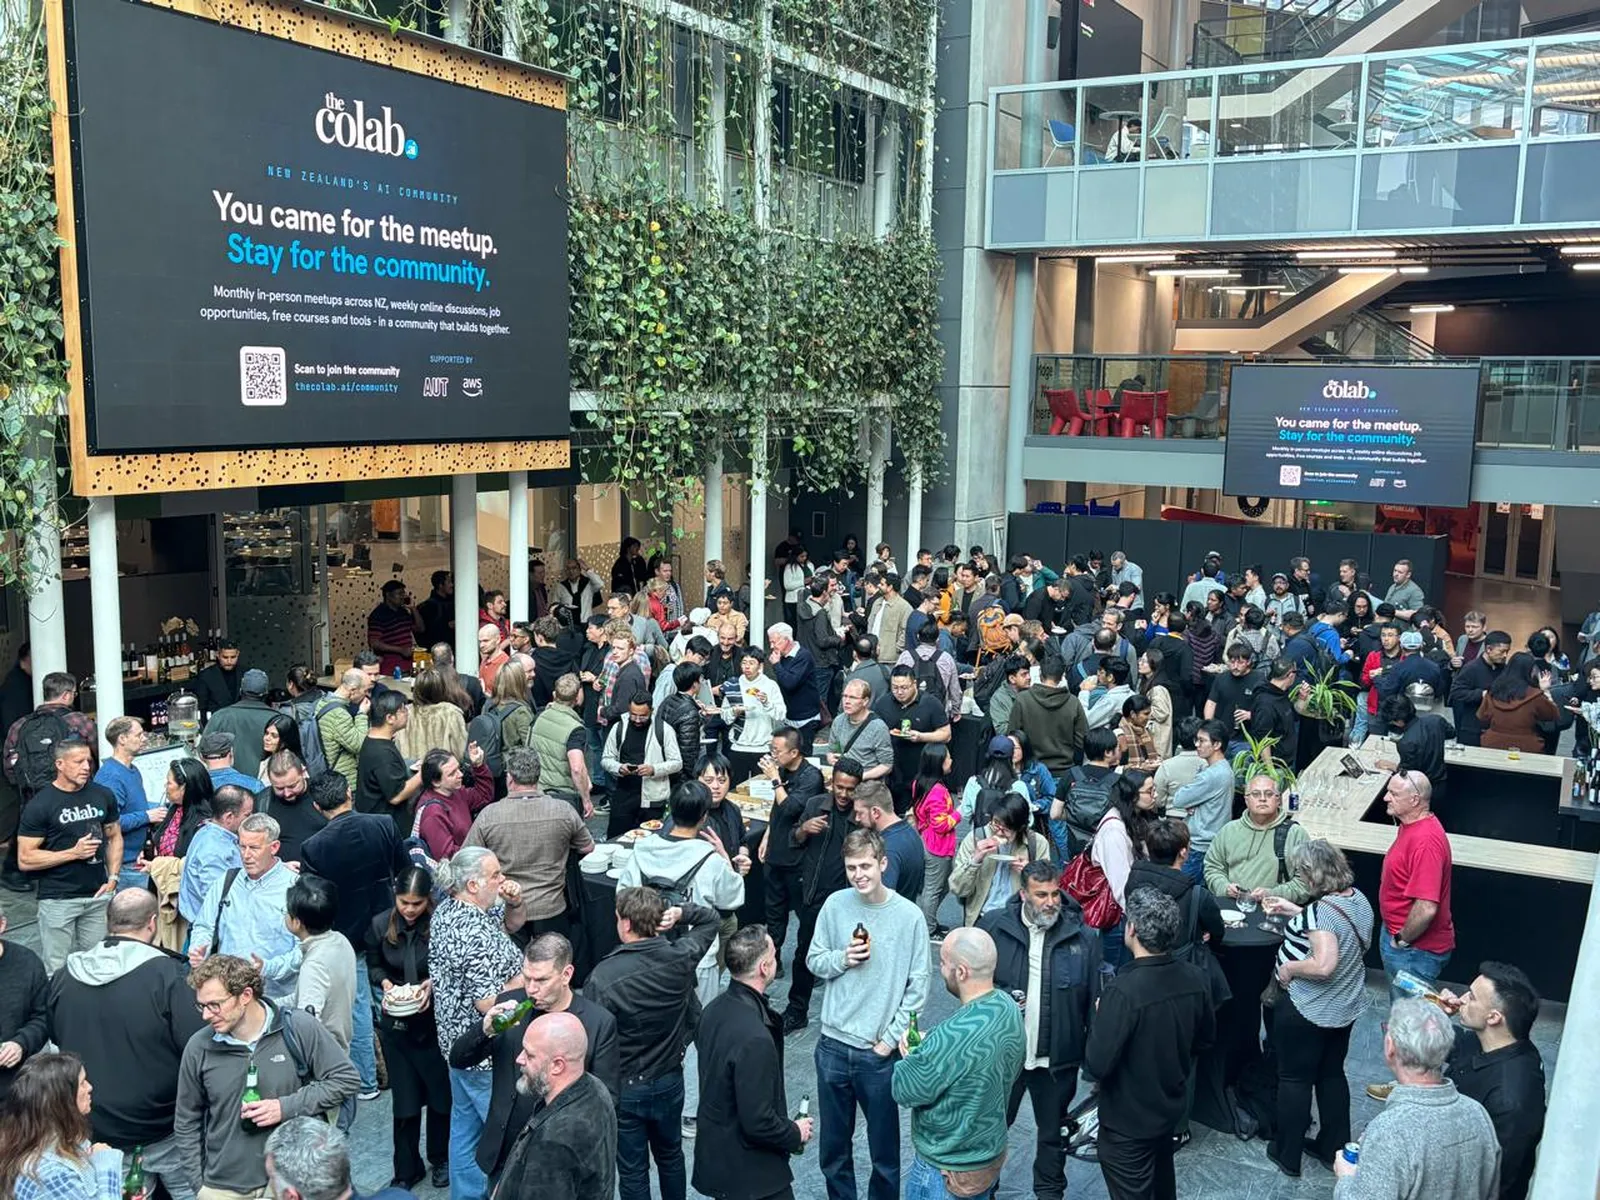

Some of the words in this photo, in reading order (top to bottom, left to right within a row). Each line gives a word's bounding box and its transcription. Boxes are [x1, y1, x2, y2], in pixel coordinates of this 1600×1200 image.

[325, 92, 345, 111] the
[267, 165, 291, 178] NEW
[301, 171, 369, 191] ZEALAND'S
[378, 183, 390, 195] AI
[399, 187, 458, 205] COMMUNITY
[212, 190, 263, 226] You
[270, 206, 336, 235] came
[340, 208, 375, 239] for
[380, 215, 415, 244] the
[420, 227, 498, 260] meetup.
[227, 233, 284, 275] Stay
[290, 240, 326, 271] for
[331, 246, 368, 275] the
[374, 256, 491, 292] community.
[213, 285, 255, 302] Monthly
[257, 288, 302, 303] in-person
[304, 294, 343, 308] meetups
[344, 297, 373, 309] across
[374, 297, 389, 310] NZ,
[390, 300, 418, 313] weekly
[420, 302, 443, 313] online
[444, 303, 488, 317] discussions,
[488, 306, 501, 318] job
[200, 308, 270, 322] opportunities,
[272, 309, 292, 322] free
[293, 312, 330, 324] courses
[331, 314, 348, 325] and
[350, 314, 371, 326] tools
[378, 316, 386, 327] in
[387, 319, 393, 328] a
[395, 319, 438, 333] community
[440, 321, 455, 332] that
[456, 321, 478, 333] builds
[479, 323, 510, 336] together.
[429, 354, 465, 364] SUPPORTED
[294, 363, 316, 374] Scan
[316, 364, 326, 374] to
[326, 364, 342, 377] join
[343, 364, 357, 375] the
[358, 365, 400, 378] community
[295, 382, 399, 393] thecolab.ai/community
[423, 377, 449, 397] AUT
[462, 378, 482, 389] aws
[1275, 416, 1297, 429] You
[1298, 418, 1330, 429] came
[1332, 418, 1350, 430] for
[1352, 418, 1371, 431] the
[1374, 420, 1422, 433] meetup.
[1279, 429, 1304, 443] Stay
[1306, 430, 1324, 441] for
[1326, 431, 1345, 442] the
[1347, 432, 1416, 447] community.
